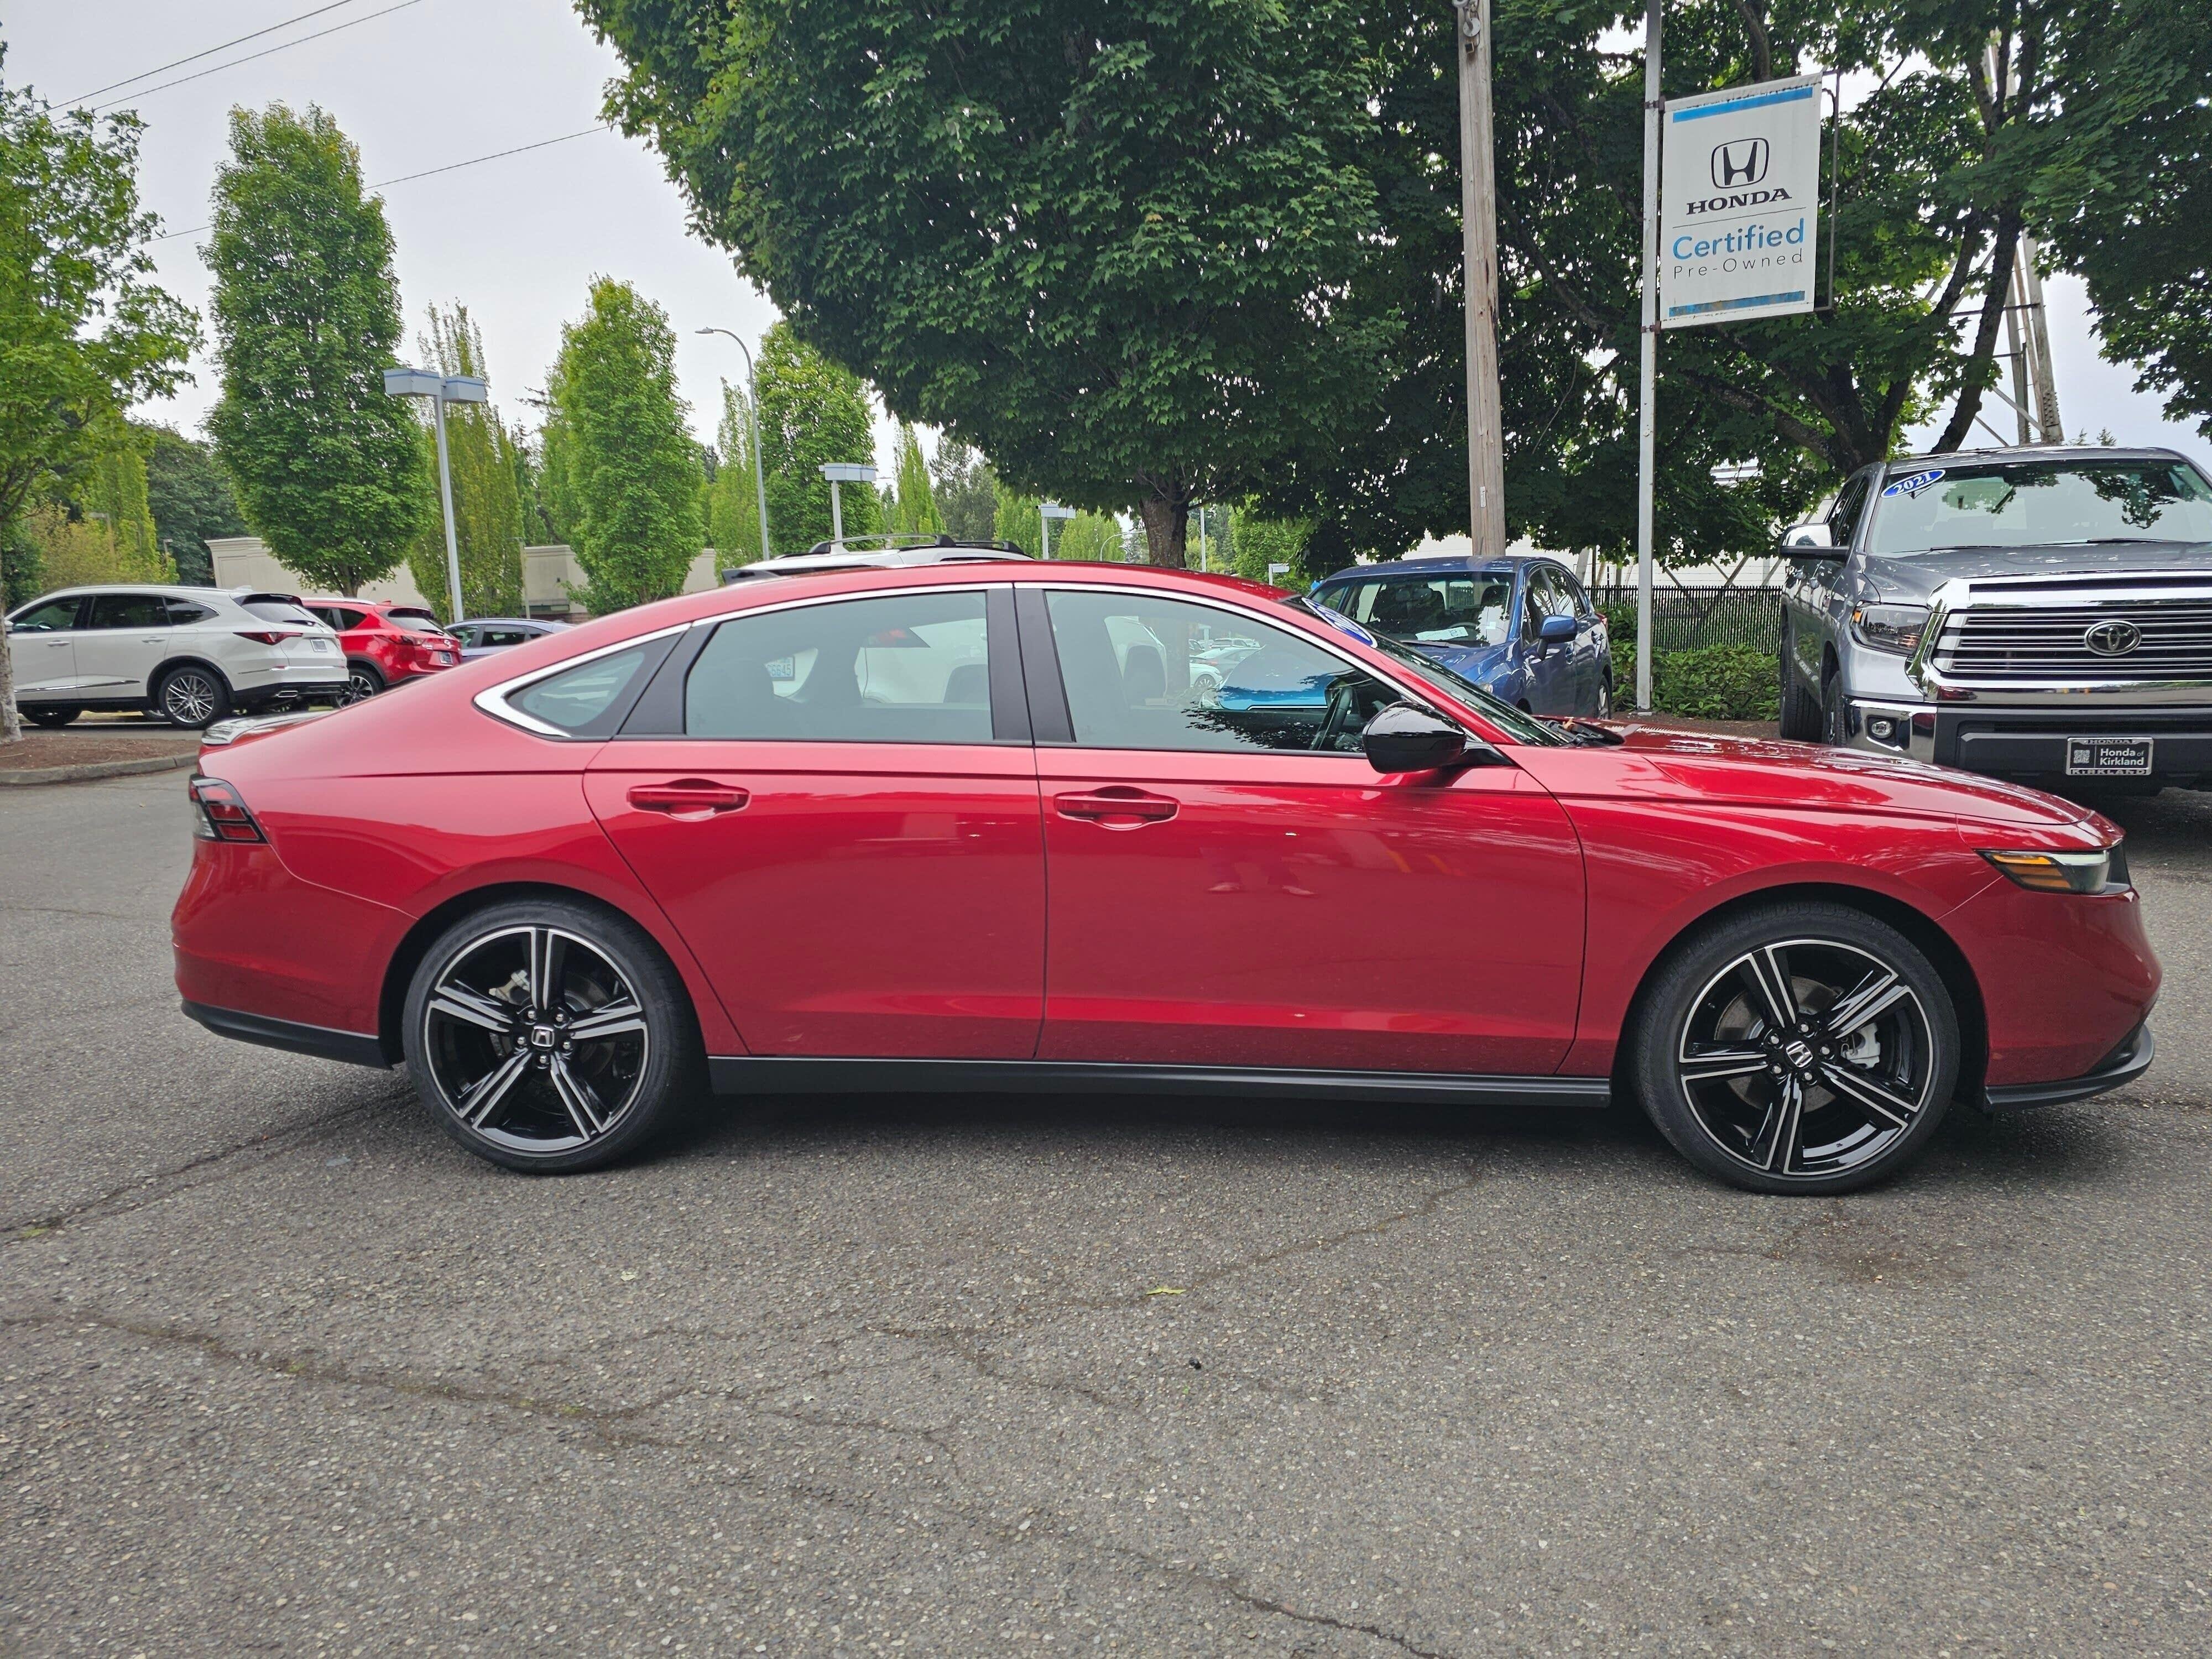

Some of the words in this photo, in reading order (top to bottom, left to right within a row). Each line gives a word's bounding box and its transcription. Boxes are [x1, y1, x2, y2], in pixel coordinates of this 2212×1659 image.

[1686, 187, 1792, 215] HONDA
[1673, 217, 1804, 260] Certified
[1674, 248, 1803, 279] Pre-Owned
[1893, 472, 1933, 494] 2021
[2100, 748, 2135, 757] Honda
[2100, 757, 2145, 765] Kirkland
